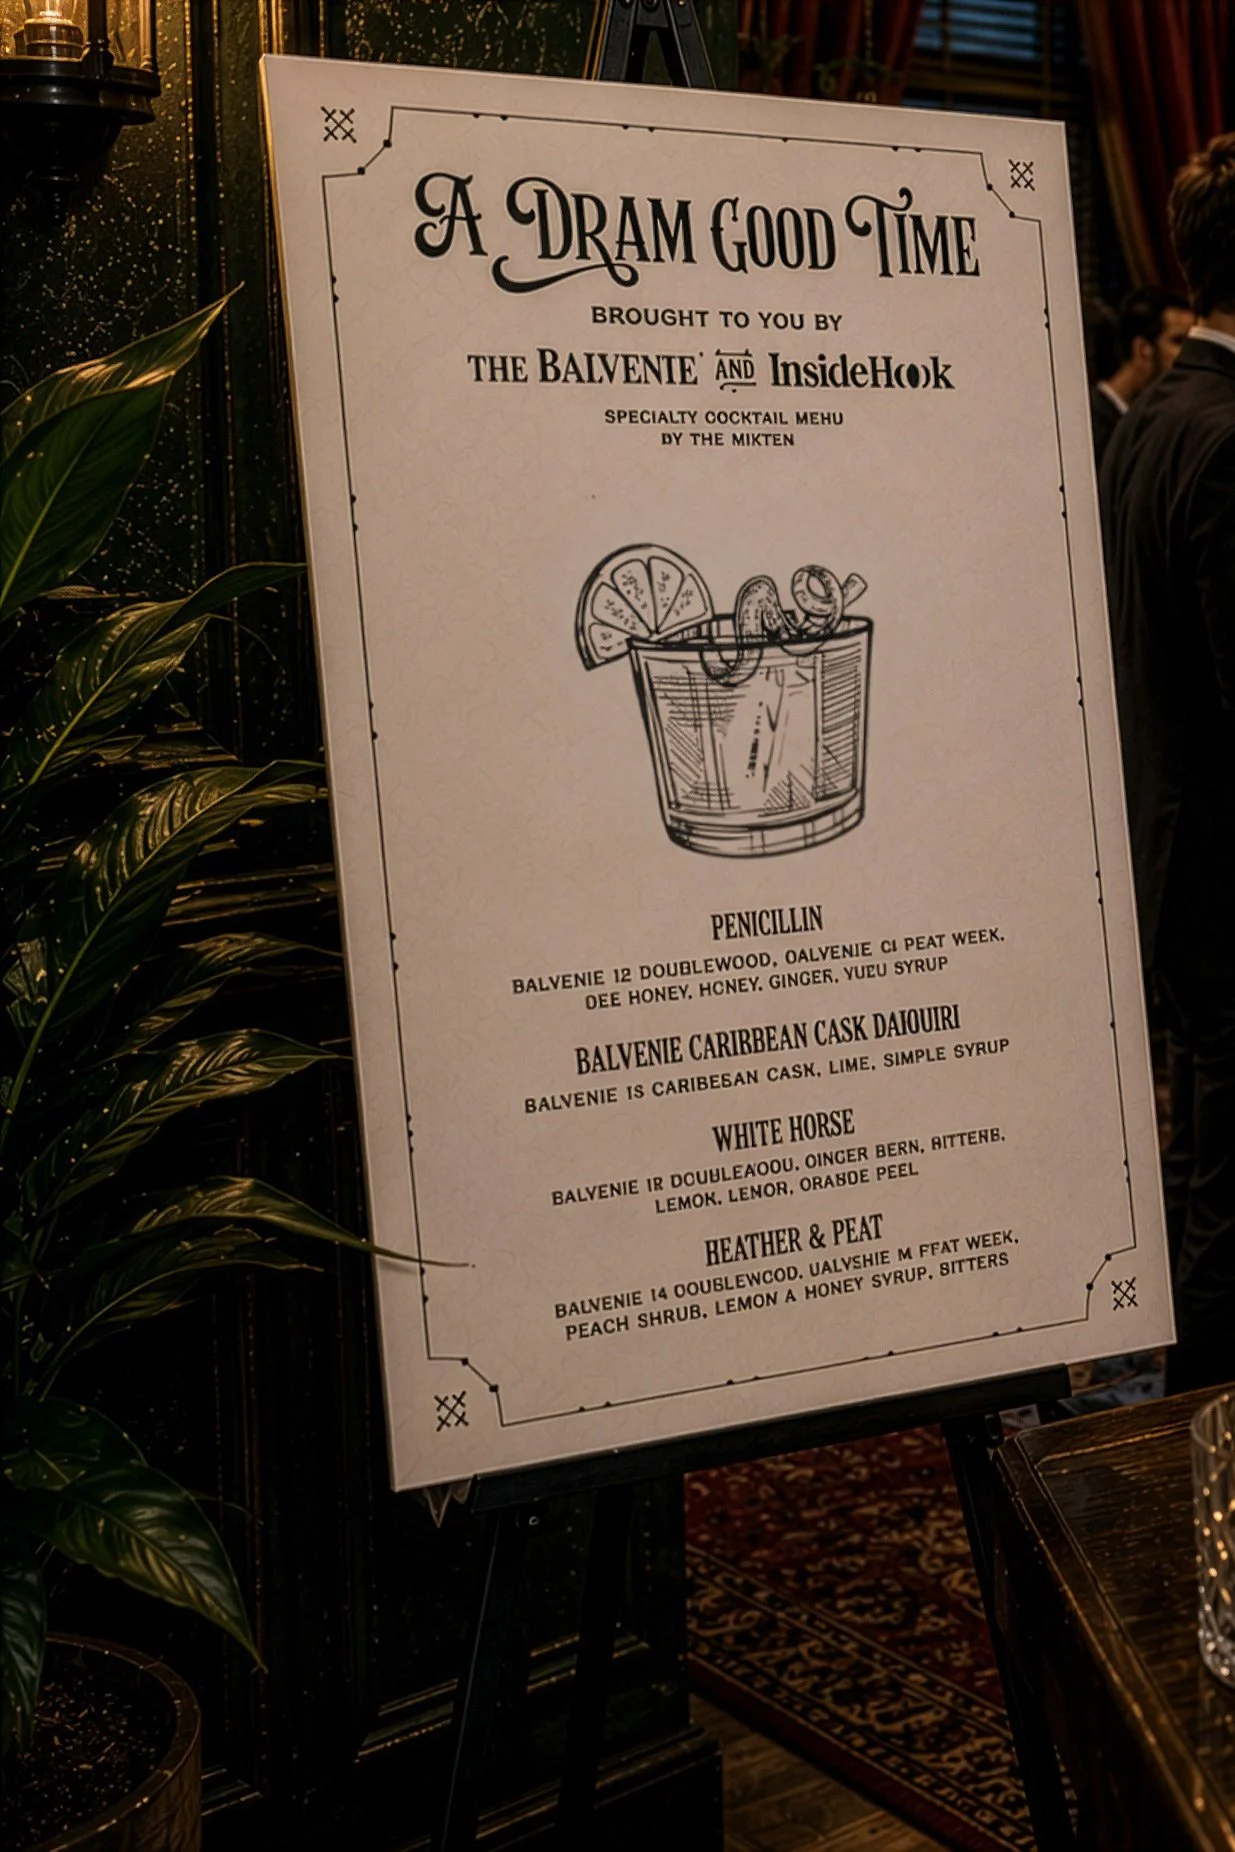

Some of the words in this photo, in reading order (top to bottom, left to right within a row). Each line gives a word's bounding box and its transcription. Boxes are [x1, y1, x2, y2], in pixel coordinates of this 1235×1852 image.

[414, 171, 489, 258] A
[491, 176, 698, 293] DRAM
[709, 196, 837, 274] GOOD
[844, 186, 981, 278] TIME
[591, 306, 709, 327] BROUGHT
[719, 311, 749, 328] TO
[758, 312, 804, 330] YOU
[815, 314, 842, 331] BY
[467, 355, 528, 383] THE
[715, 357, 756, 383] AND
[605, 409, 697, 424] SPECIALTY
[690, 433, 724, 446] THE
[711, 905, 823, 940] PENICILLIN
[512, 970, 604, 994] BALVENIE
[904, 934, 945, 951] PEAT
[894, 956, 948, 975] SYRUP
[575, 1036, 683, 1075] BALVENIE
[814, 1014, 868, 1046] CASK
[525, 1088, 617, 1113] BALVENIE
[884, 1047, 946, 1067] SIMPLE
[954, 1039, 1009, 1058] SYRUP
[712, 1117, 784, 1152] WHITE
[789, 1108, 856, 1142] HORSE
[877, 1162, 918, 1181] PEEL
[809, 1224, 826, 1249] &
[832, 1213, 883, 1246] PEAT
[555, 1291, 642, 1318] BALVENIE
[565, 1316, 629, 1340] PEACH
[715, 1292, 777, 1315] LEMON
[805, 1277, 863, 1300] HONEY
